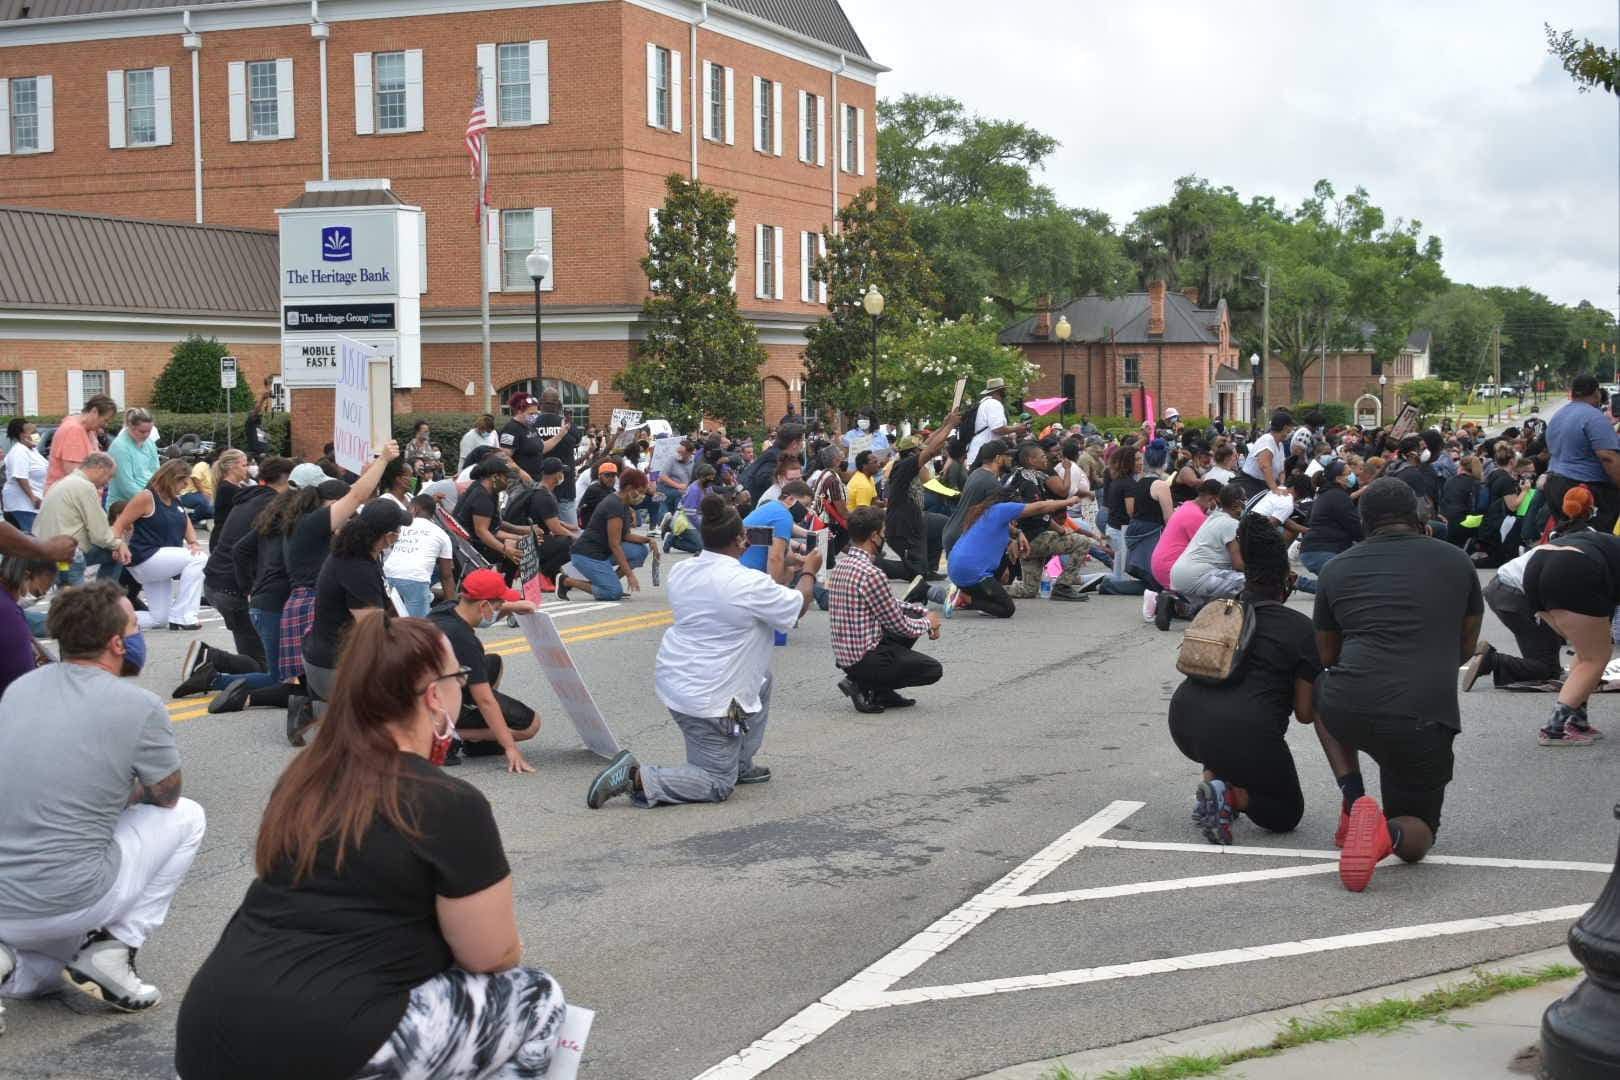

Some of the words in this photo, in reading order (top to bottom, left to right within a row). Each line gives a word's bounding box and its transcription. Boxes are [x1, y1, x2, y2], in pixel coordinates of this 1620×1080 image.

[287, 269, 309, 284] The
[311, 268, 357, 285] Heritage
[360, 267, 391, 282] Bank
[299, 313, 315, 323] The
[315, 313, 345, 324] Heritage
[346, 313, 369, 324] Group
[302, 345, 336, 356] MOBILE
[306, 357, 328, 368] FAST
[342, 398, 365, 427] NOT
